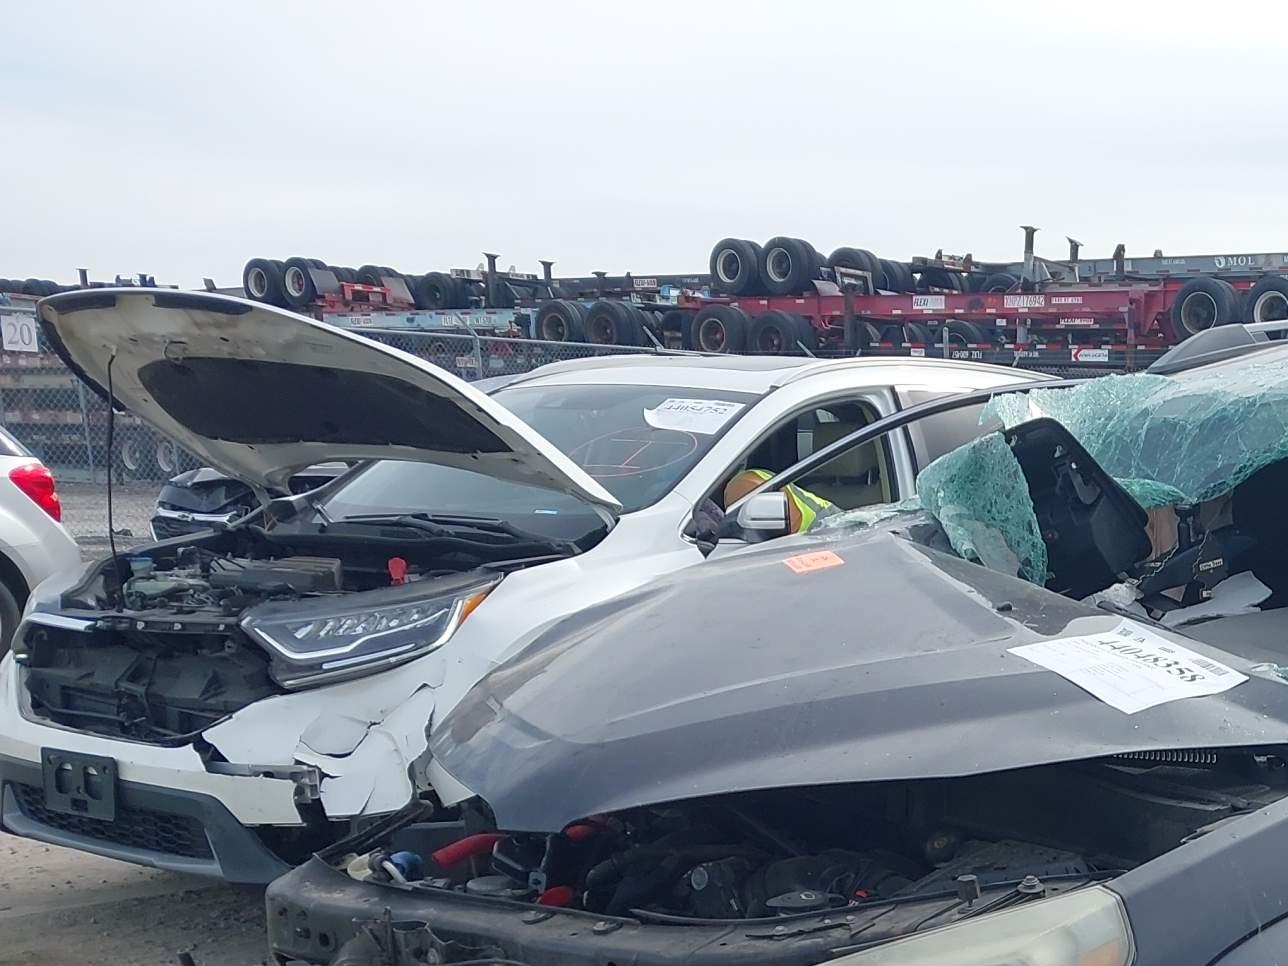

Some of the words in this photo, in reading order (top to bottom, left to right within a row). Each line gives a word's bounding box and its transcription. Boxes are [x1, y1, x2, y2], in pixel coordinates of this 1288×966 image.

[1227, 256, 1255, 266] MOL
[7, 322, 33, 346] 20
[1097, 639, 1206, 683] 44048358
